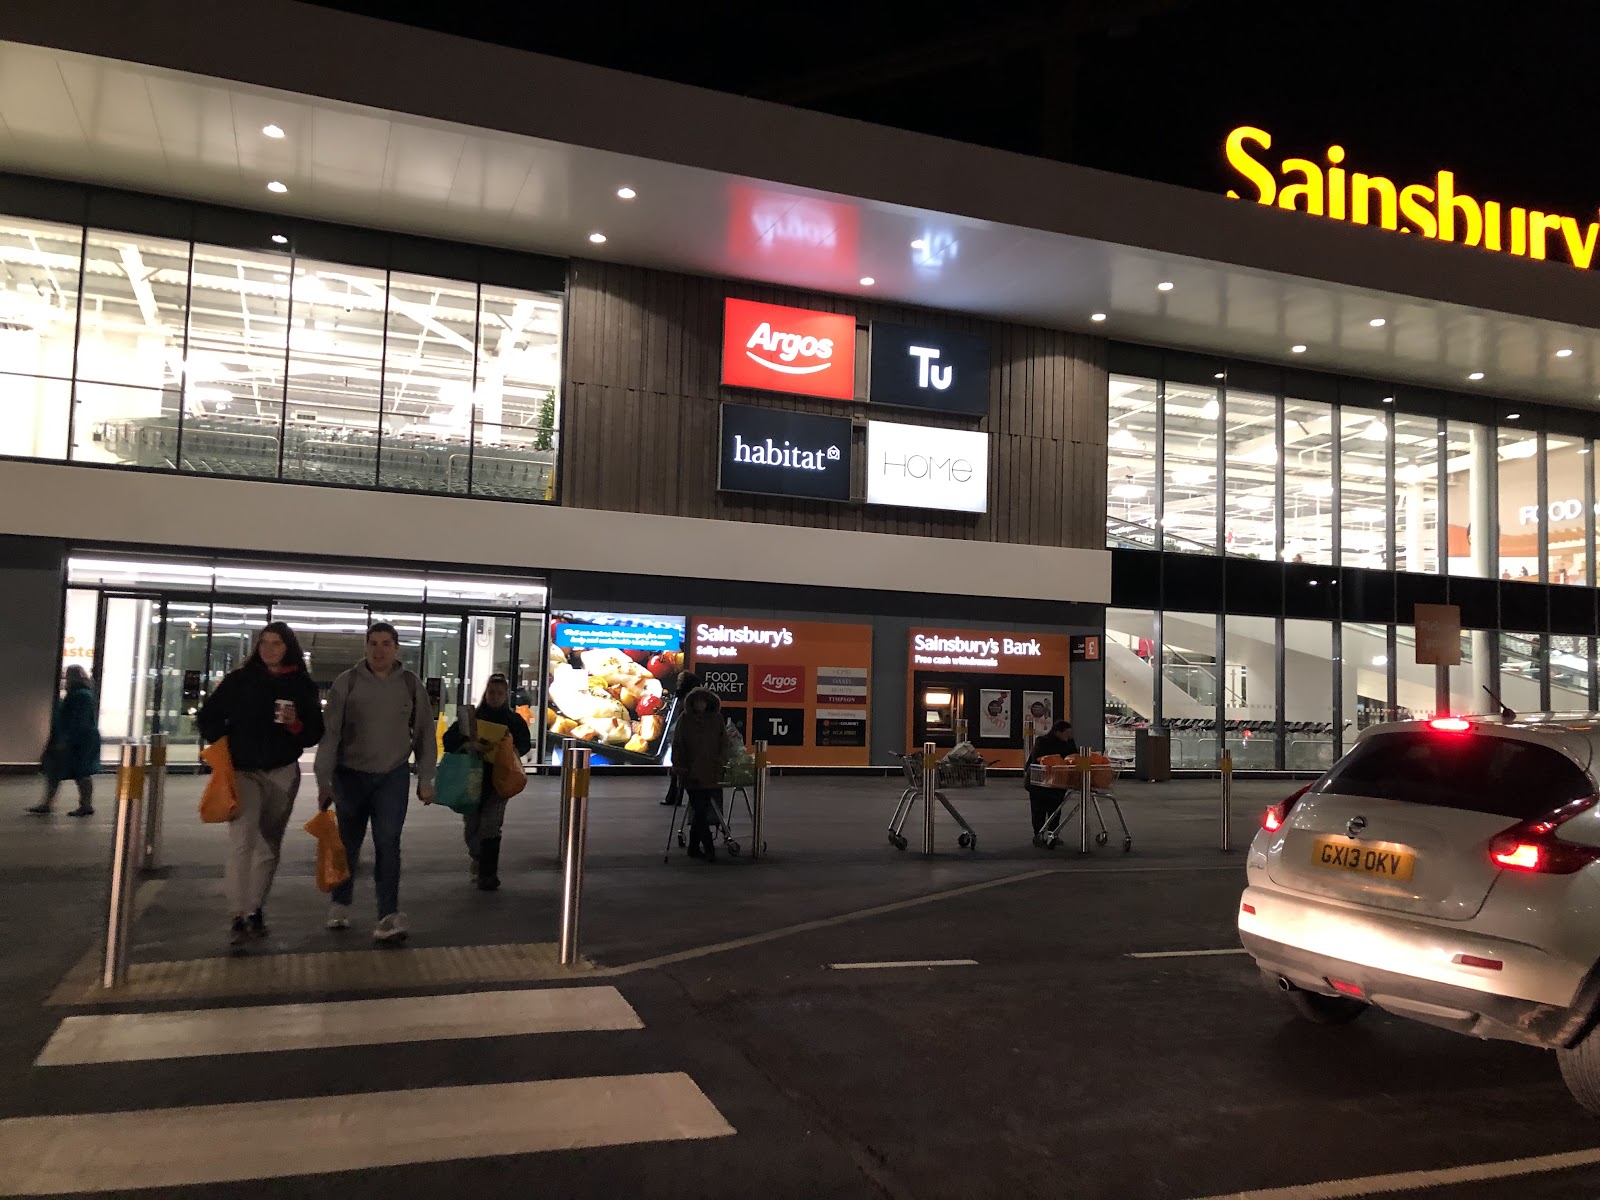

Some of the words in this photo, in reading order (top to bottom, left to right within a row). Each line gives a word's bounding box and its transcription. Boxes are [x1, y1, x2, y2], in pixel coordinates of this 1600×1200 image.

[746, 322, 834, 362] Argos
[909, 345, 953, 390] Tu
[734, 435, 826, 471] habitat
[697, 623, 793, 648] Sainsbury's
[914, 634, 999, 657] Sainsbury's
[1003, 638, 1041, 656] Bank
[914, 655, 932, 663] Free
[932, 655, 951, 665] cash
[705, 671, 738, 683] FOOD
[762, 674, 797, 689] Argos
[768, 718, 789, 736] Tu
[1321, 844, 1361, 868] GX13
[1364, 851, 1401, 875] OKV
